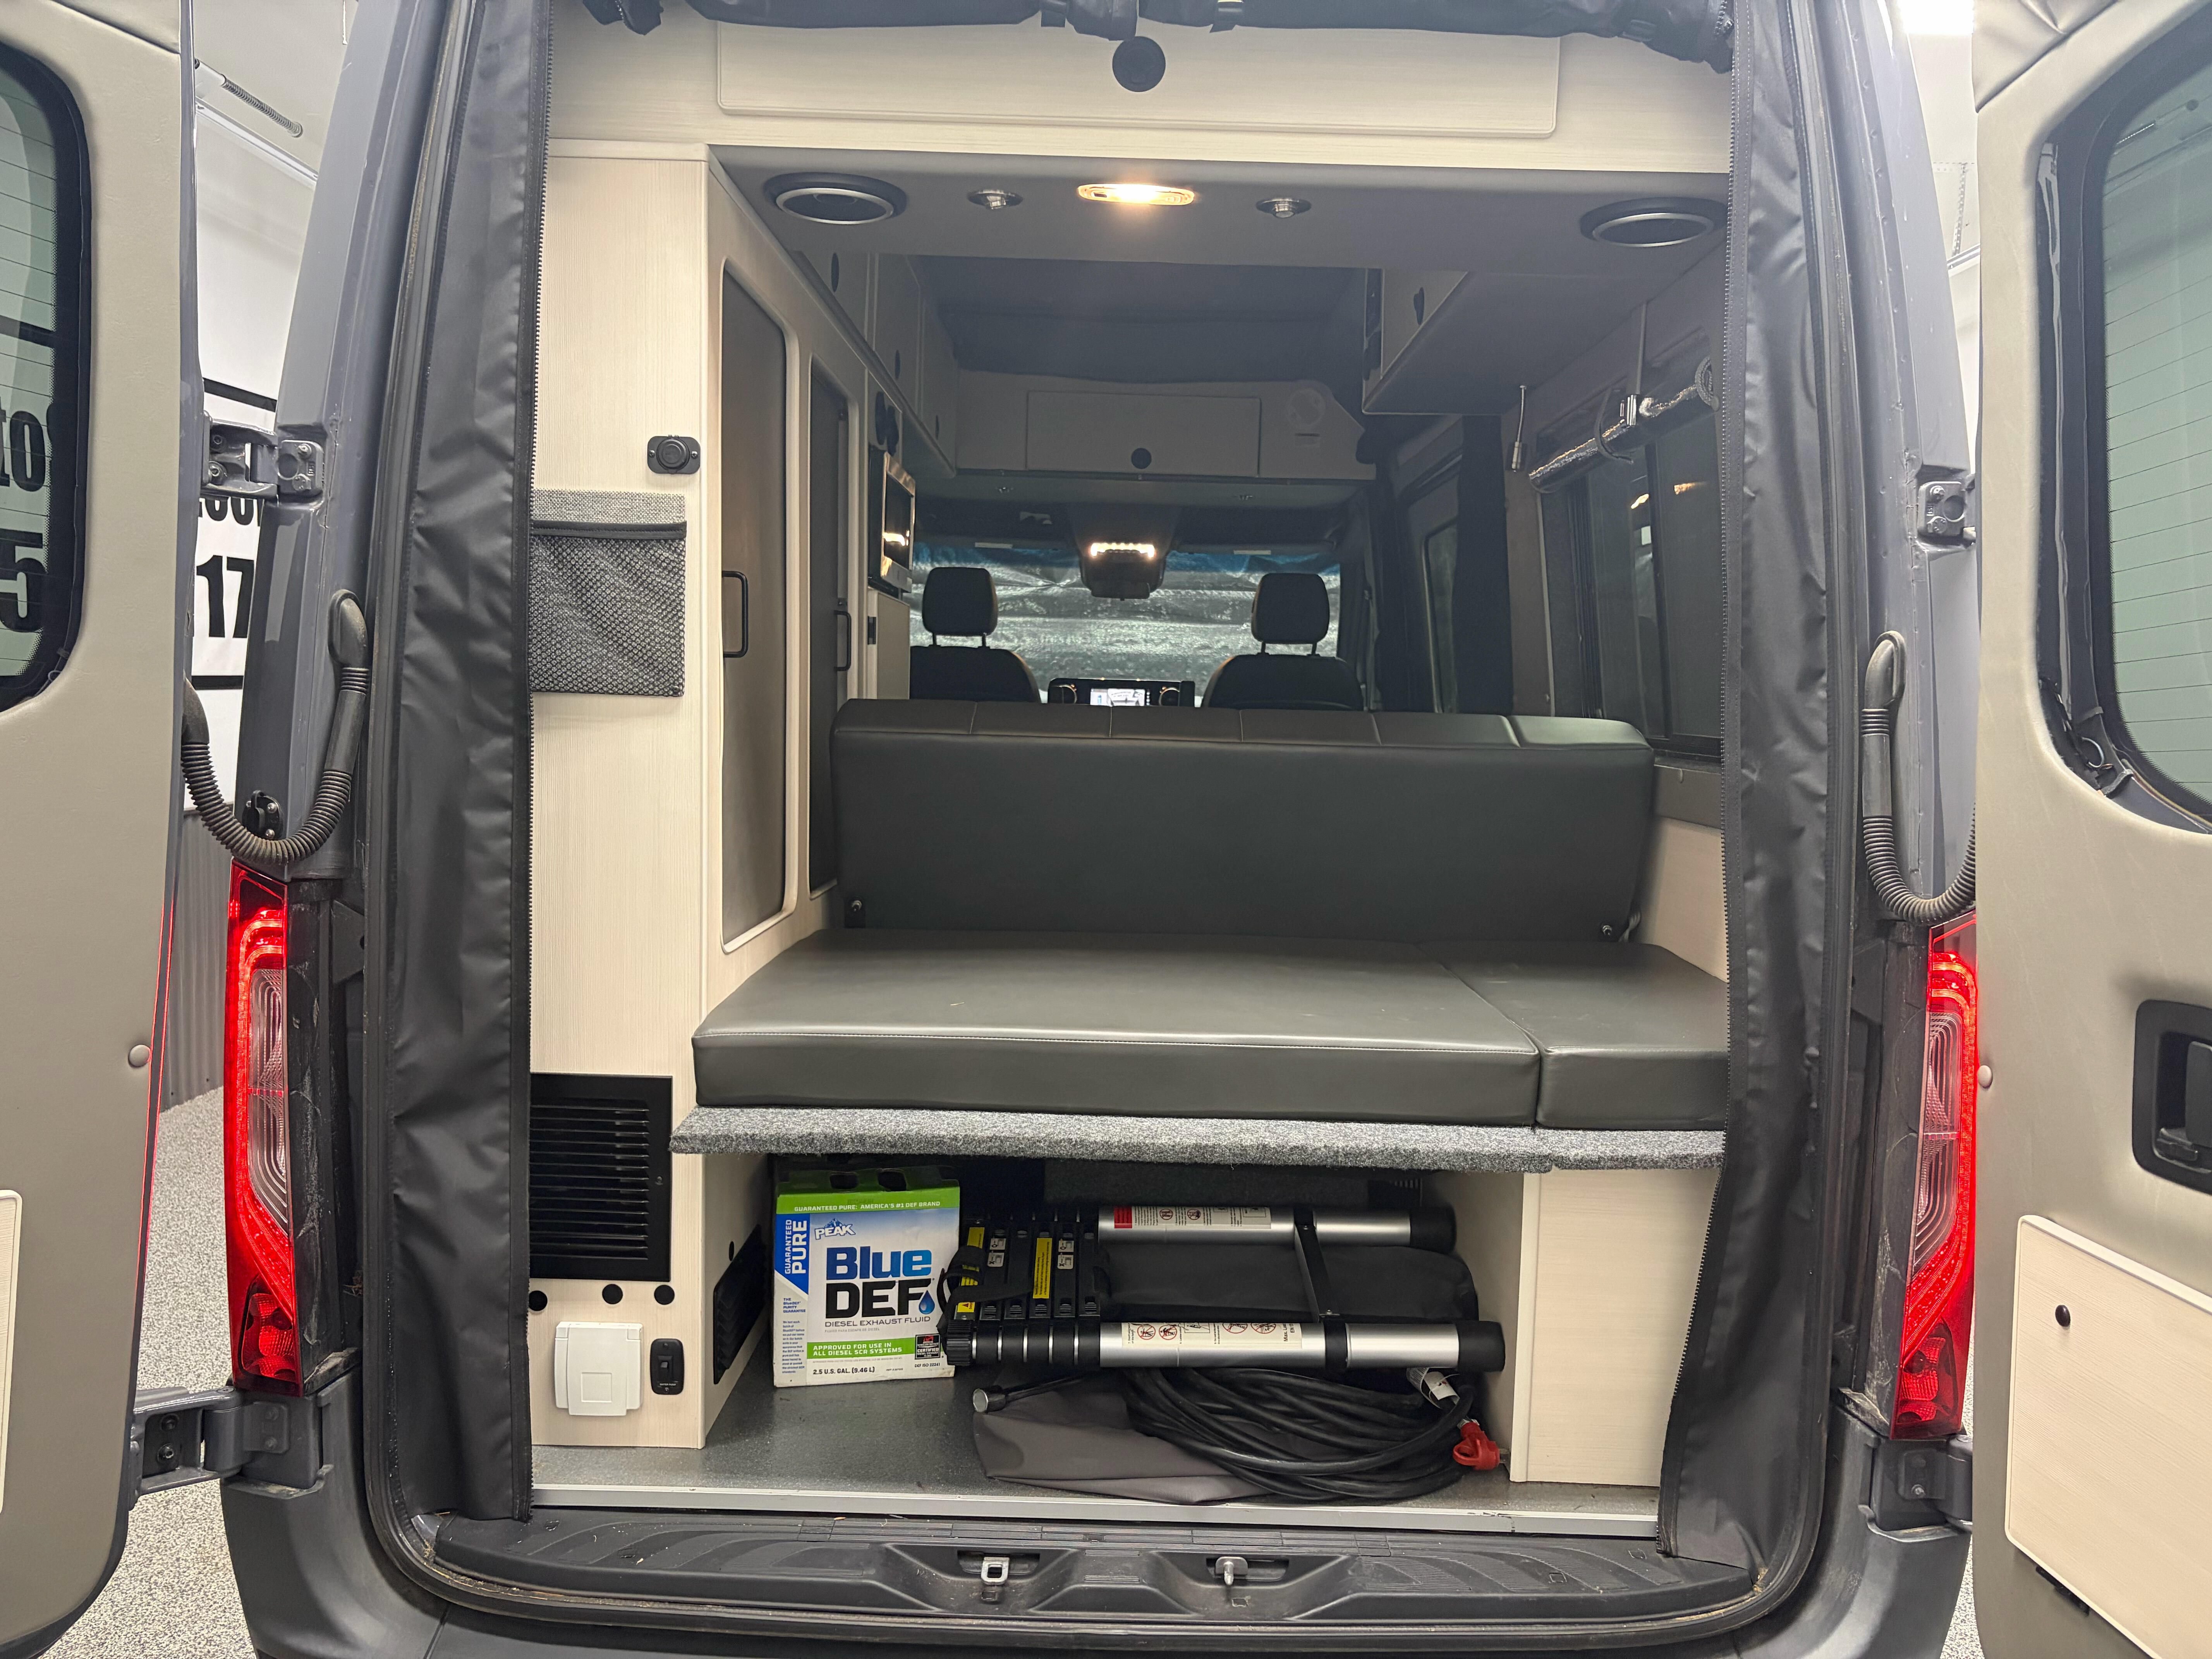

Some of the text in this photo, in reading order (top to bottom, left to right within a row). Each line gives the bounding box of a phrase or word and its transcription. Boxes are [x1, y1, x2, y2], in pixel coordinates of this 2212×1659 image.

[196, 555, 254, 638] 17
[792, 1221, 807, 1274] PURE
[815, 1224, 855, 1240] PEAK
[826, 1246, 932, 1280] Blue
[826, 1278, 931, 1319] DEF
